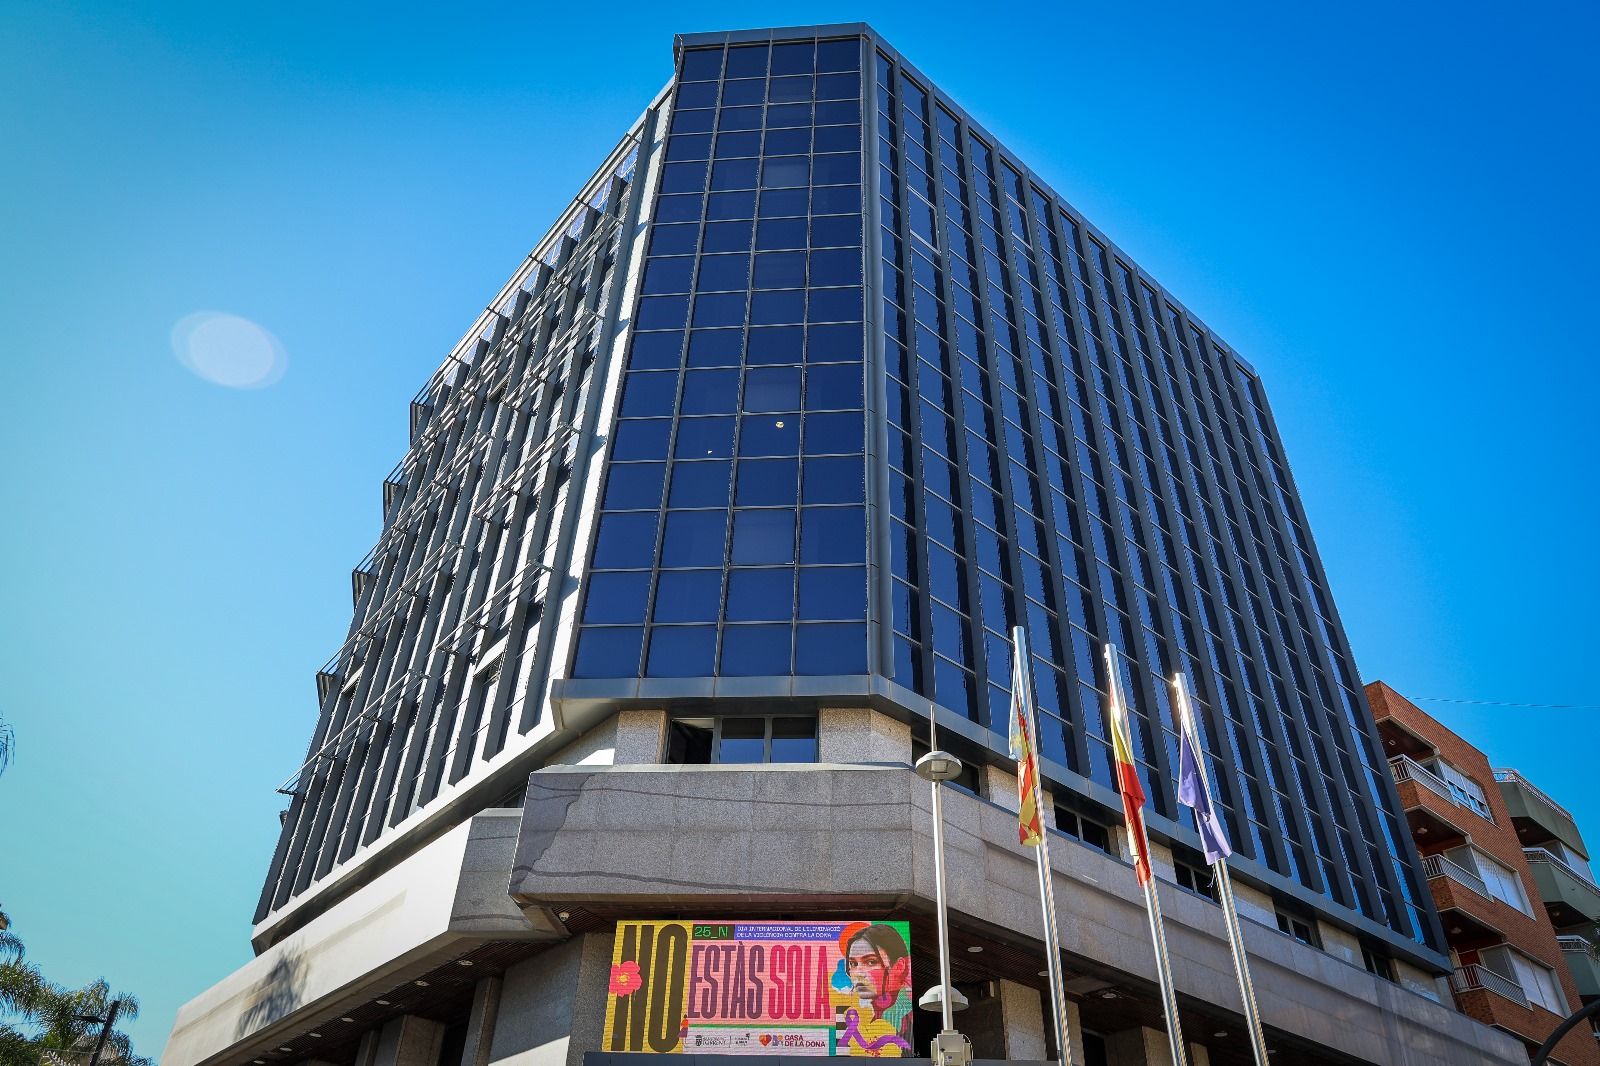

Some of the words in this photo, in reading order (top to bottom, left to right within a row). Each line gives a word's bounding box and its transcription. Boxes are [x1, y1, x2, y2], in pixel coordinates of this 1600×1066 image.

[611, 924, 688, 1052] NO
[687, 941, 765, 1019] ESTÀS
[768, 945, 831, 1020] SOLA
